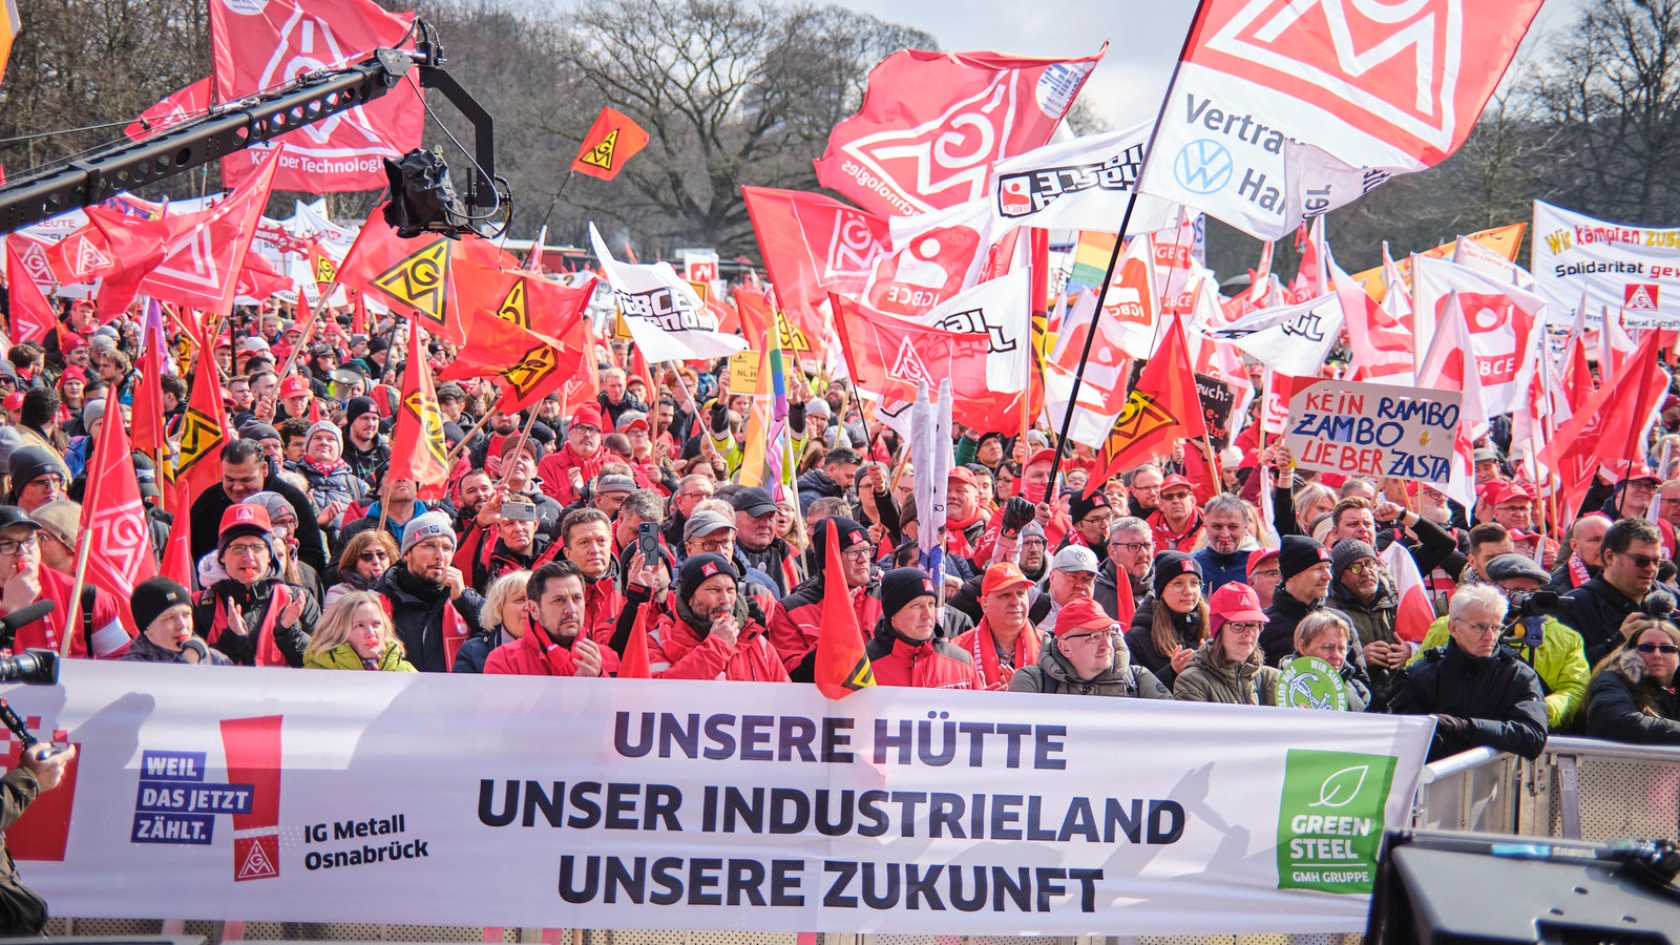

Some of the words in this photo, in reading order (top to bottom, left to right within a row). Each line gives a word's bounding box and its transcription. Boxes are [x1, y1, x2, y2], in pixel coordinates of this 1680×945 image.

[1186, 93, 1285, 155] Vertra
[251, 151, 299, 170] Köber
[301, 156, 385, 176] Technologi
[1545, 228, 1572, 256] Wir
[1477, 357, 1515, 376] BCE
[1305, 392, 1364, 415] KEIN
[1377, 397, 1460, 430] RAMBO
[1292, 414, 1404, 447] ZAMBO
[1301, 436, 1384, 476] LIEBER
[1387, 448, 1451, 484] ZASTA
[1310, 659, 1328, 673] WIR
[1327, 669, 1343, 691] SIND
[613, 711, 855, 763] UNSERE
[873, 710, 1067, 770] HÜTTE
[146, 757, 197, 776] WEIL
[142, 788, 185, 807] DAS
[188, 790, 249, 812] JETZT
[477, 779, 683, 831] UNSER
[702, 785, 1186, 845] INDUSTRIELAND
[137, 815, 206, 840] ZÄHLT.
[305, 823, 328, 844] IG
[334, 814, 405, 841] Metall
[1291, 814, 1371, 837] GREEN
[305, 839, 429, 871] Osnabrück
[1290, 838, 1359, 859] STEEL
[558, 855, 805, 907] UNSERE
[823, 860, 1104, 913] ZUKUNFT
[1292, 871, 1320, 882] GMH
[1322, 871, 1370, 883] GRUPPE
